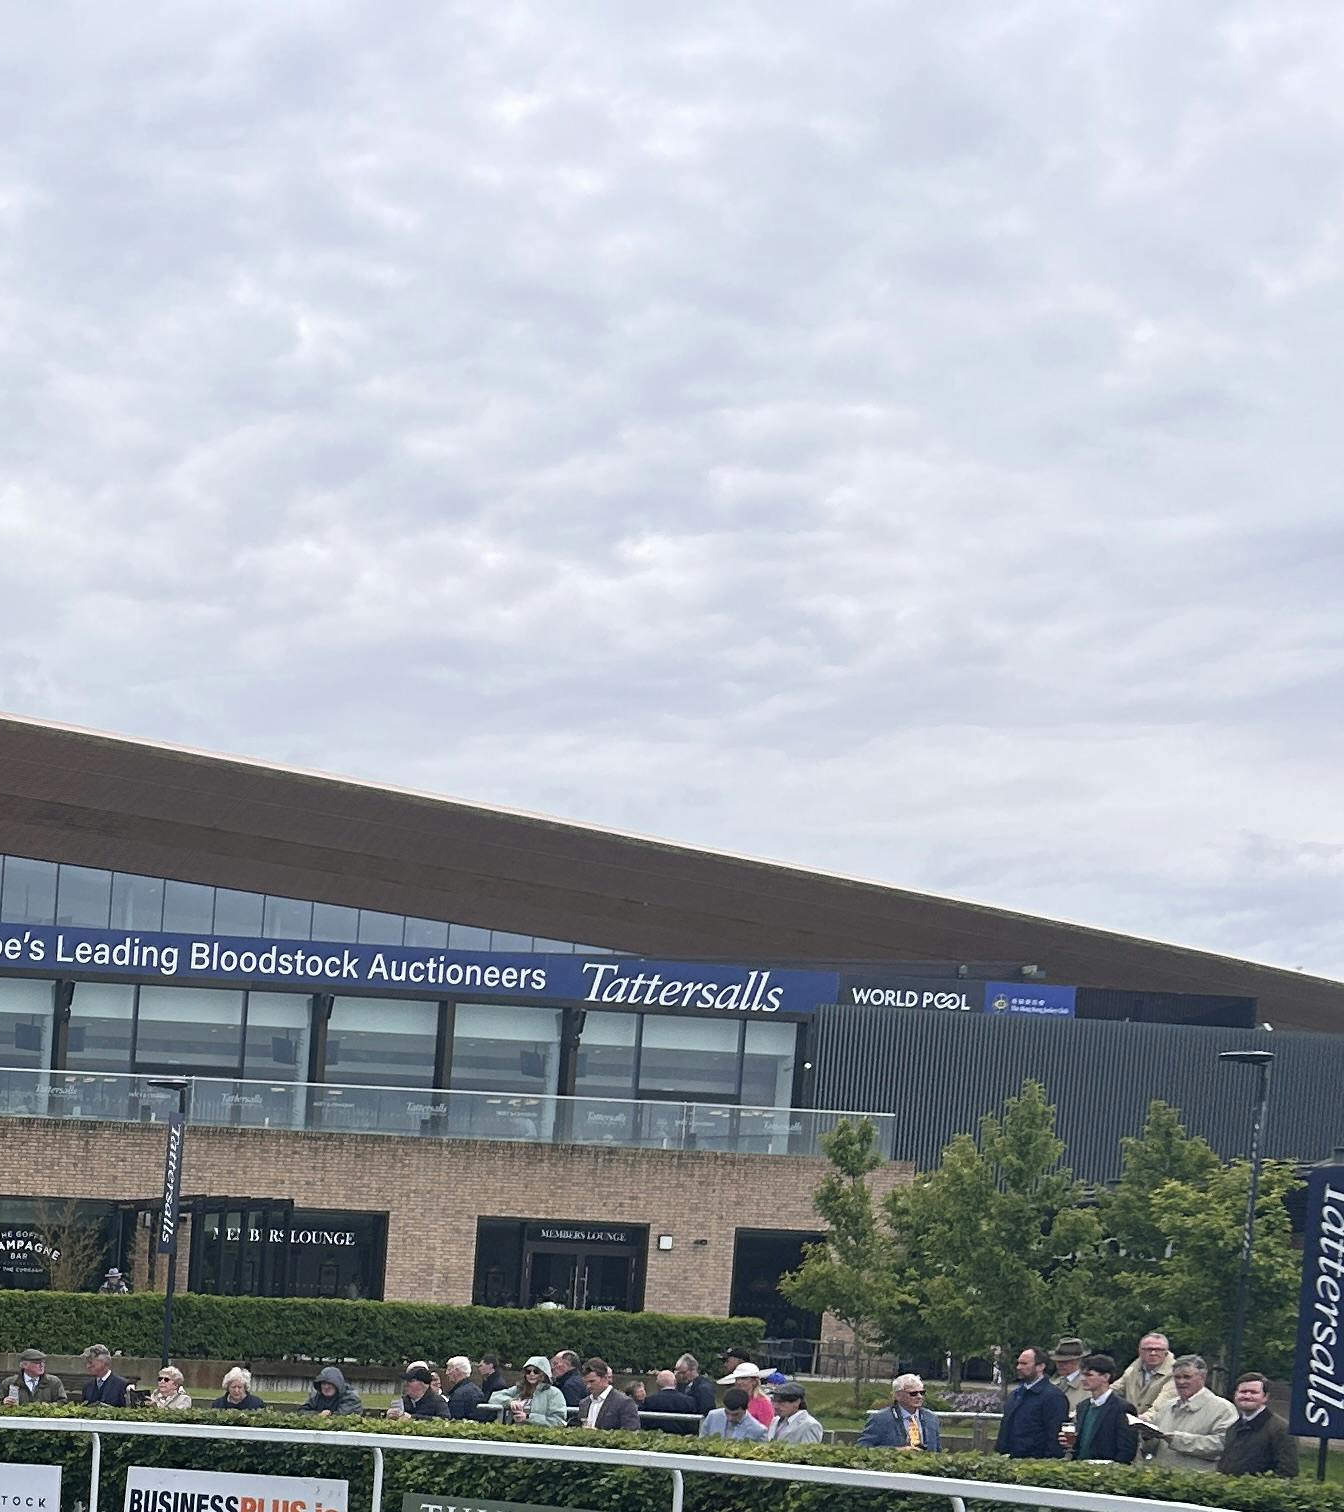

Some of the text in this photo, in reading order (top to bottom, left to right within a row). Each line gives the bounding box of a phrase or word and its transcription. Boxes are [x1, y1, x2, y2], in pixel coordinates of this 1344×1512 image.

[56, 934, 179, 976] Leading
[190, 942, 359, 979] Bloodstock
[367, 953, 547, 991] Auctioneers
[582, 962, 784, 1013] Tattersalls
[851, 987, 971, 1011] WORLD POOL
[162, 1123, 182, 1244] Tattersalls
[10, 1252, 28, 1260] BAR
[290, 1229, 355, 1246] LOUNGE
